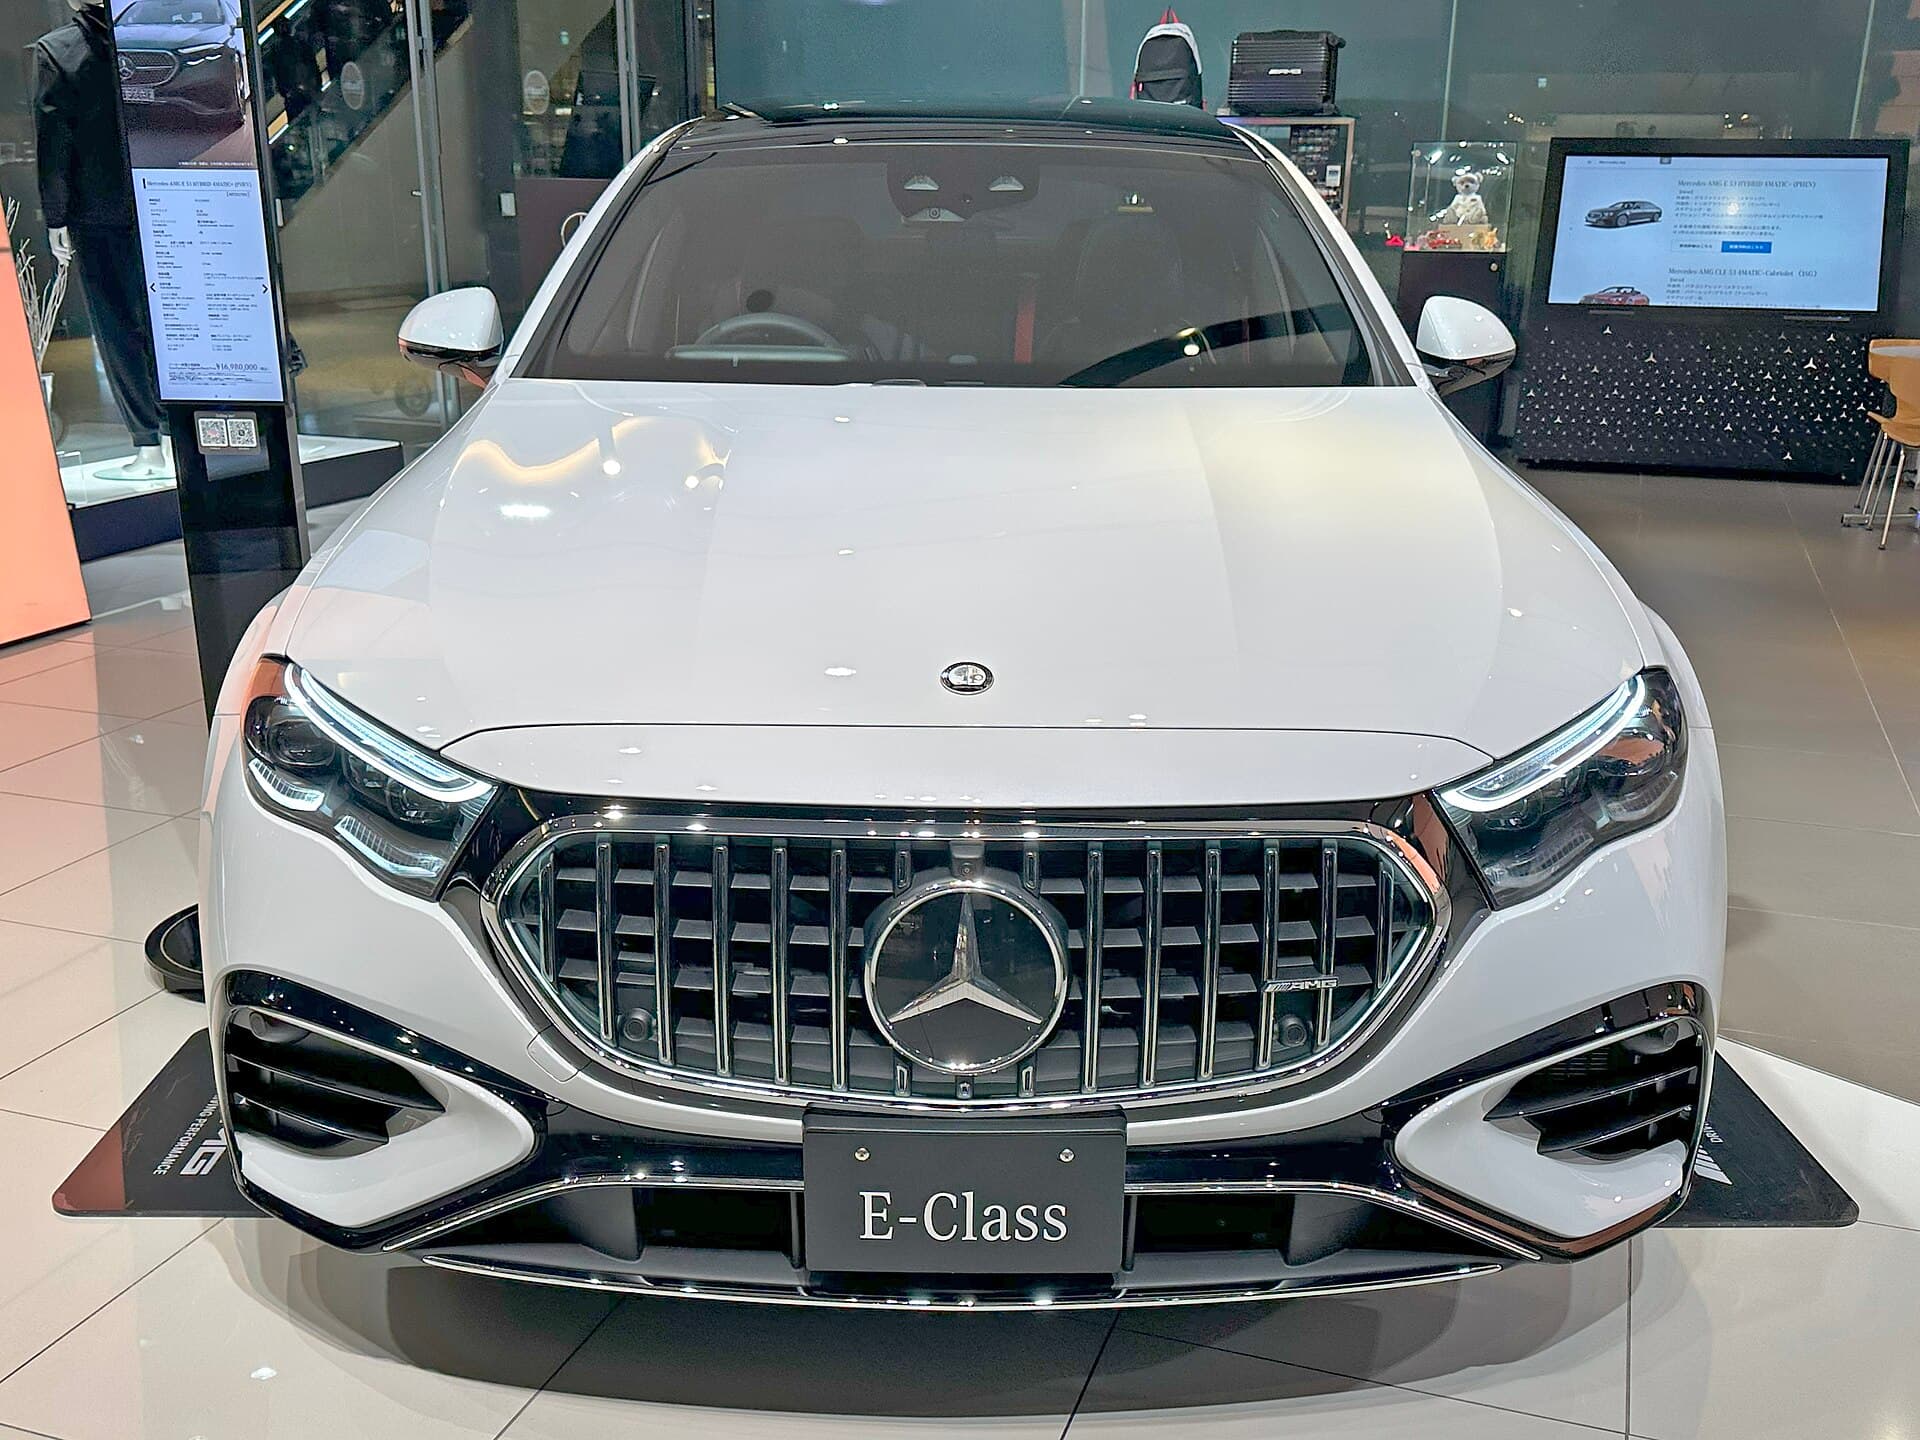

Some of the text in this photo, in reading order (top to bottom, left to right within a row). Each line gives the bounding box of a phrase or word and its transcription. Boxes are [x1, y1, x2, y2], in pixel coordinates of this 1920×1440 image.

[1286, 979, 1338, 992] AMG
[153, 1117, 208, 1175] PERFORMANCE
[859, 1190, 1068, 1243] E-Class
